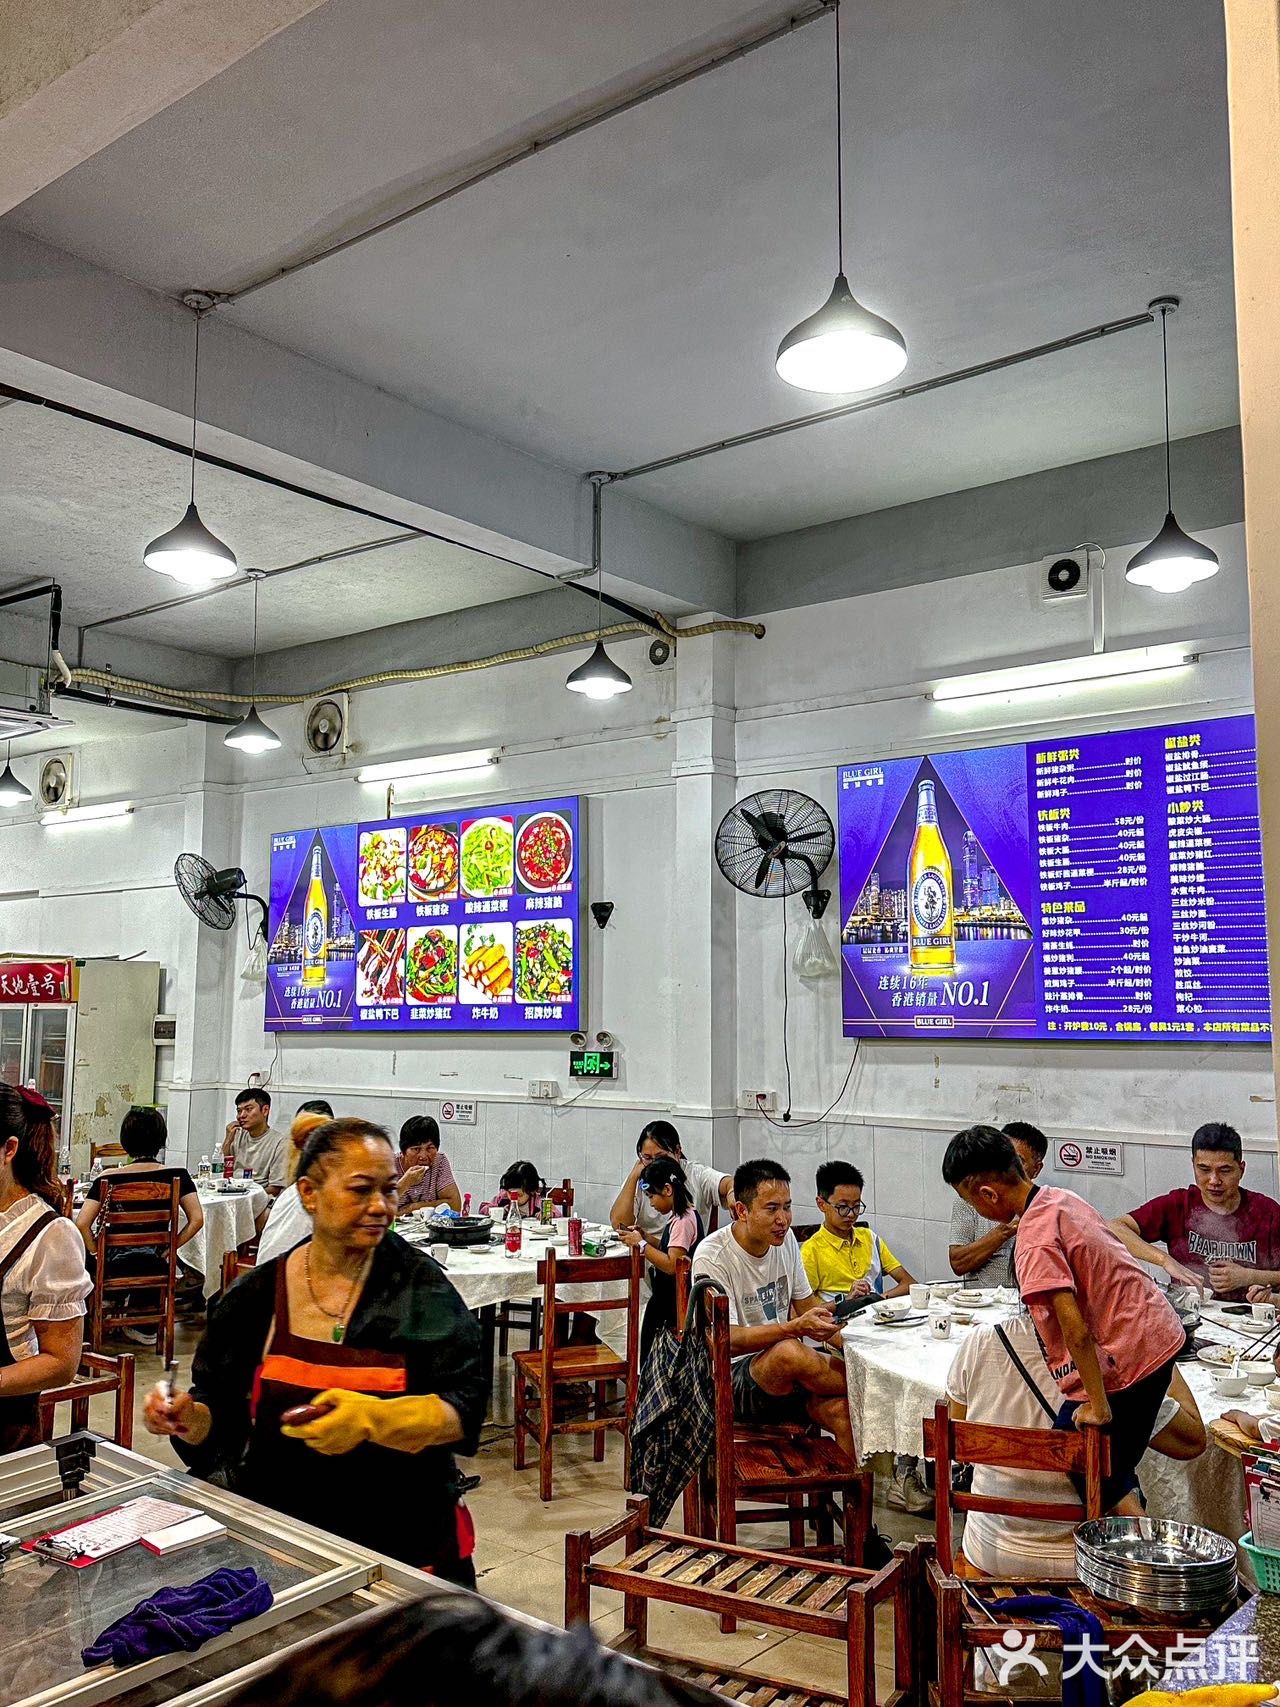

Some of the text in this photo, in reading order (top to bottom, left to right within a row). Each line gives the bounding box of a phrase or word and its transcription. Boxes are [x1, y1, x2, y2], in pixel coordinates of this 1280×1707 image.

[913, 937, 951, 946] BLUE GIRL
[1, 972, 56, 996] 天地壹号
[878, 975, 928, 990] 连续16年
[316, 990, 342, 1008] NO.1
[892, 981, 989, 1007] 香港销量 NO.1
[472, 1007, 499, 1019] 炸牛奶
[916, 1018, 952, 1026] BLUE GIRL
[1085, 1146, 1117, 1156] 禁止吸烟
